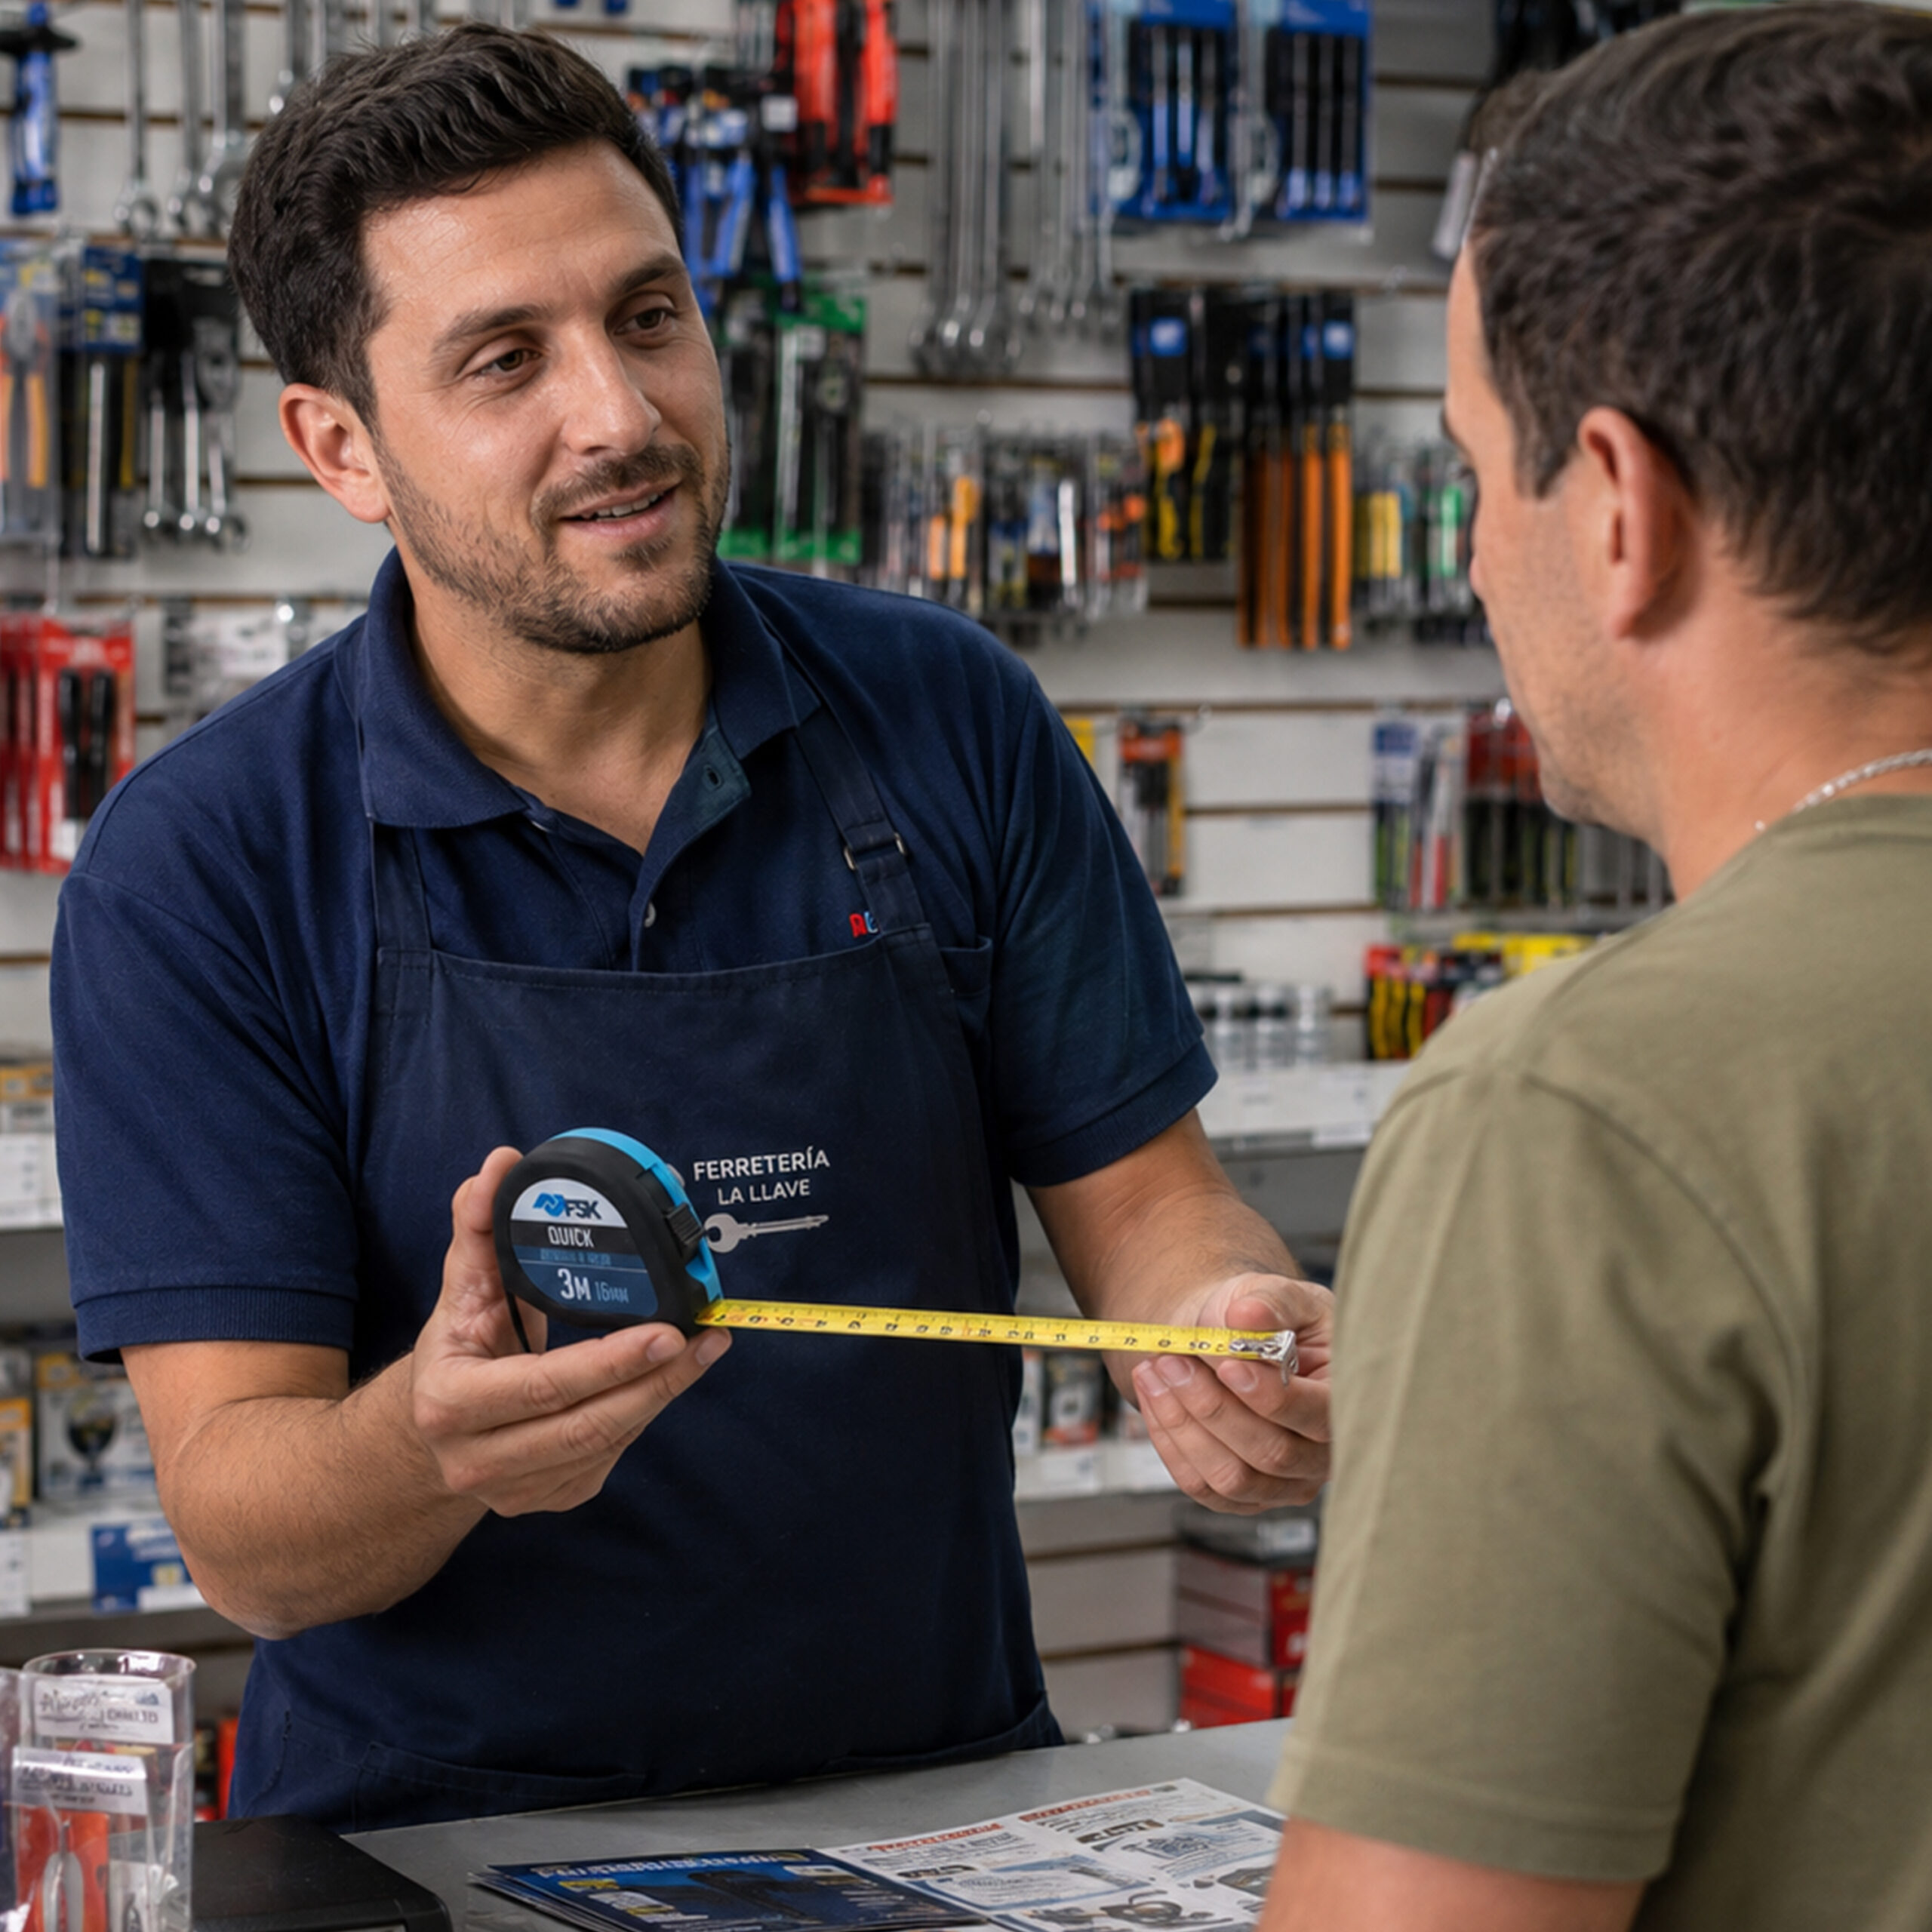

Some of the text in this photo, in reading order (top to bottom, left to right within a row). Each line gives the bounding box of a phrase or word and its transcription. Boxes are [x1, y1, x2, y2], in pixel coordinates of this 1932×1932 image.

[694, 1146, 830, 1181] FERRETERÍA
[718, 1178, 810, 1205] LA LLAVE
[564, 1199, 601, 1220] FSK
[548, 1226, 595, 1248] QUICK
[558, 1268, 592, 1301] 3M
